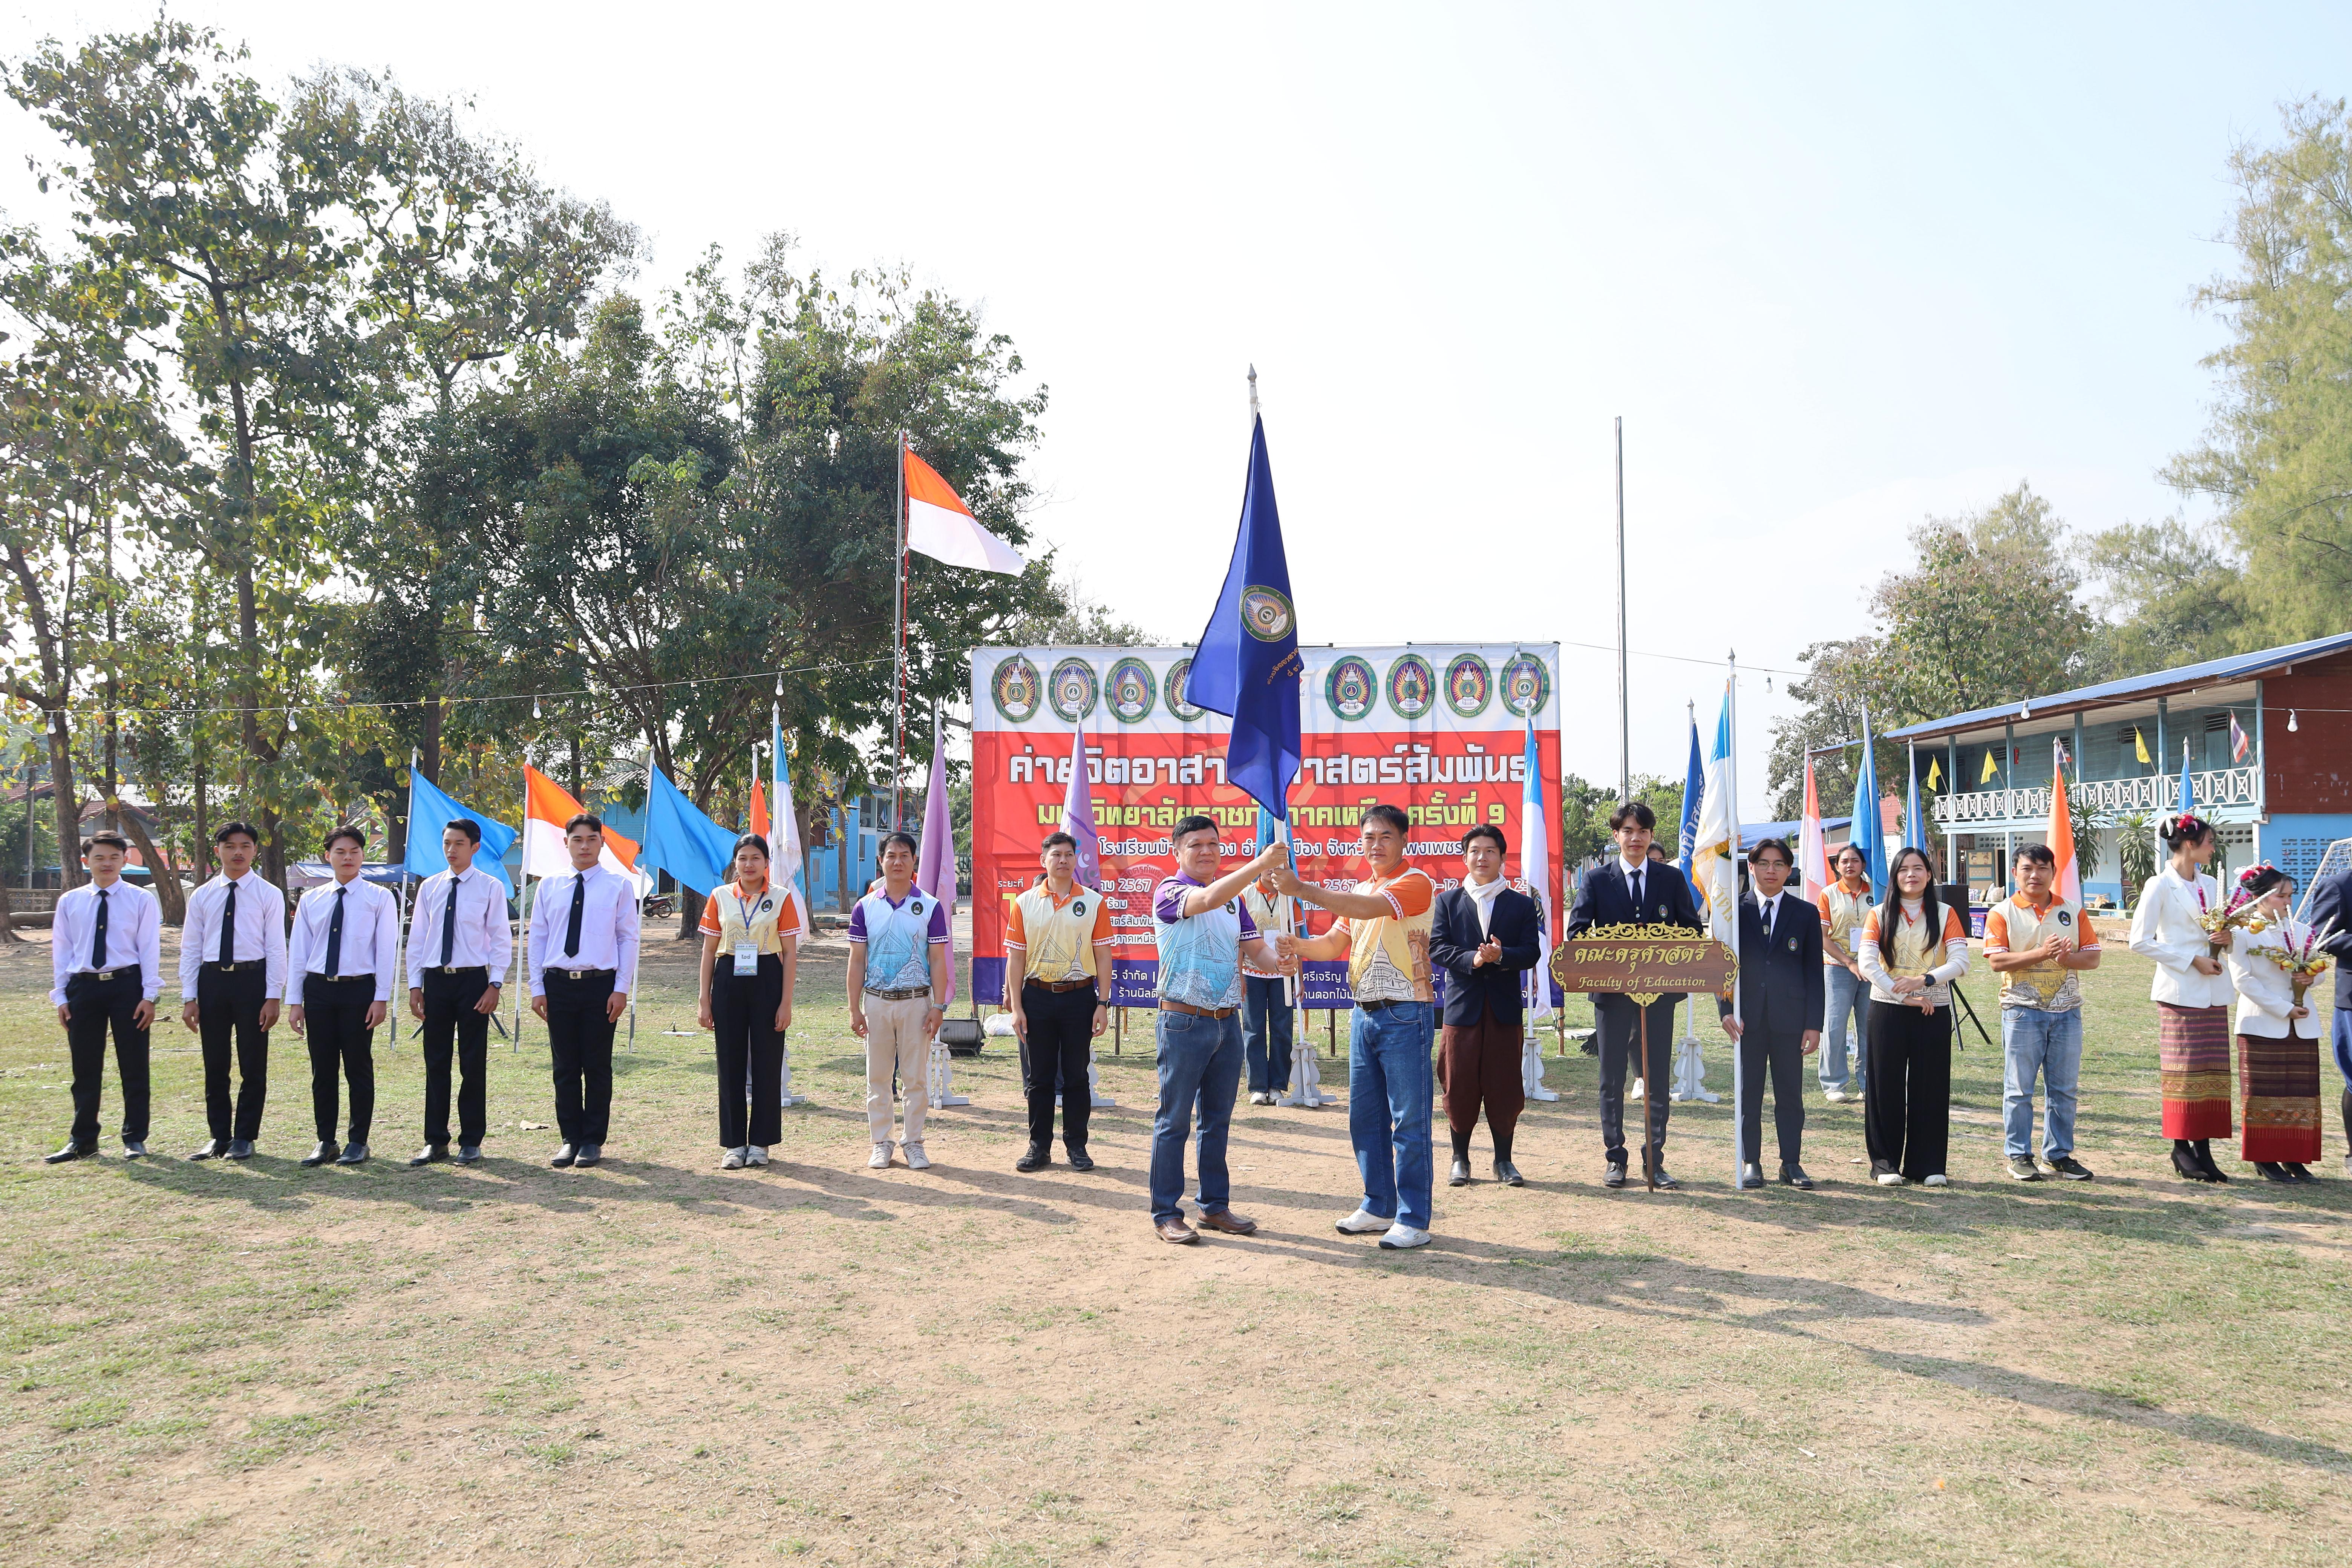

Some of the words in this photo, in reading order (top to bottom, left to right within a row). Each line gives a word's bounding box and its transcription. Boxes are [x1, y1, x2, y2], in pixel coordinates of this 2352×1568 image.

[1407, 791, 1476, 825] ครั้งที่
[998, 876, 1023, 887] ระยะที่
[1118, 879, 1152, 892] 2567
[1115, 933, 1156, 944] ภาคเหนือ
[1574, 942, 1714, 974] คณะครุศาสตร์
[1122, 969, 1147, 980] จำกัด
[1302, 970, 1341, 983] ศรีเจริญ
[1578, 976, 1623, 991] Faculty
[1626, 975, 1641, 991] of
[1644, 975, 1706, 987] Education
